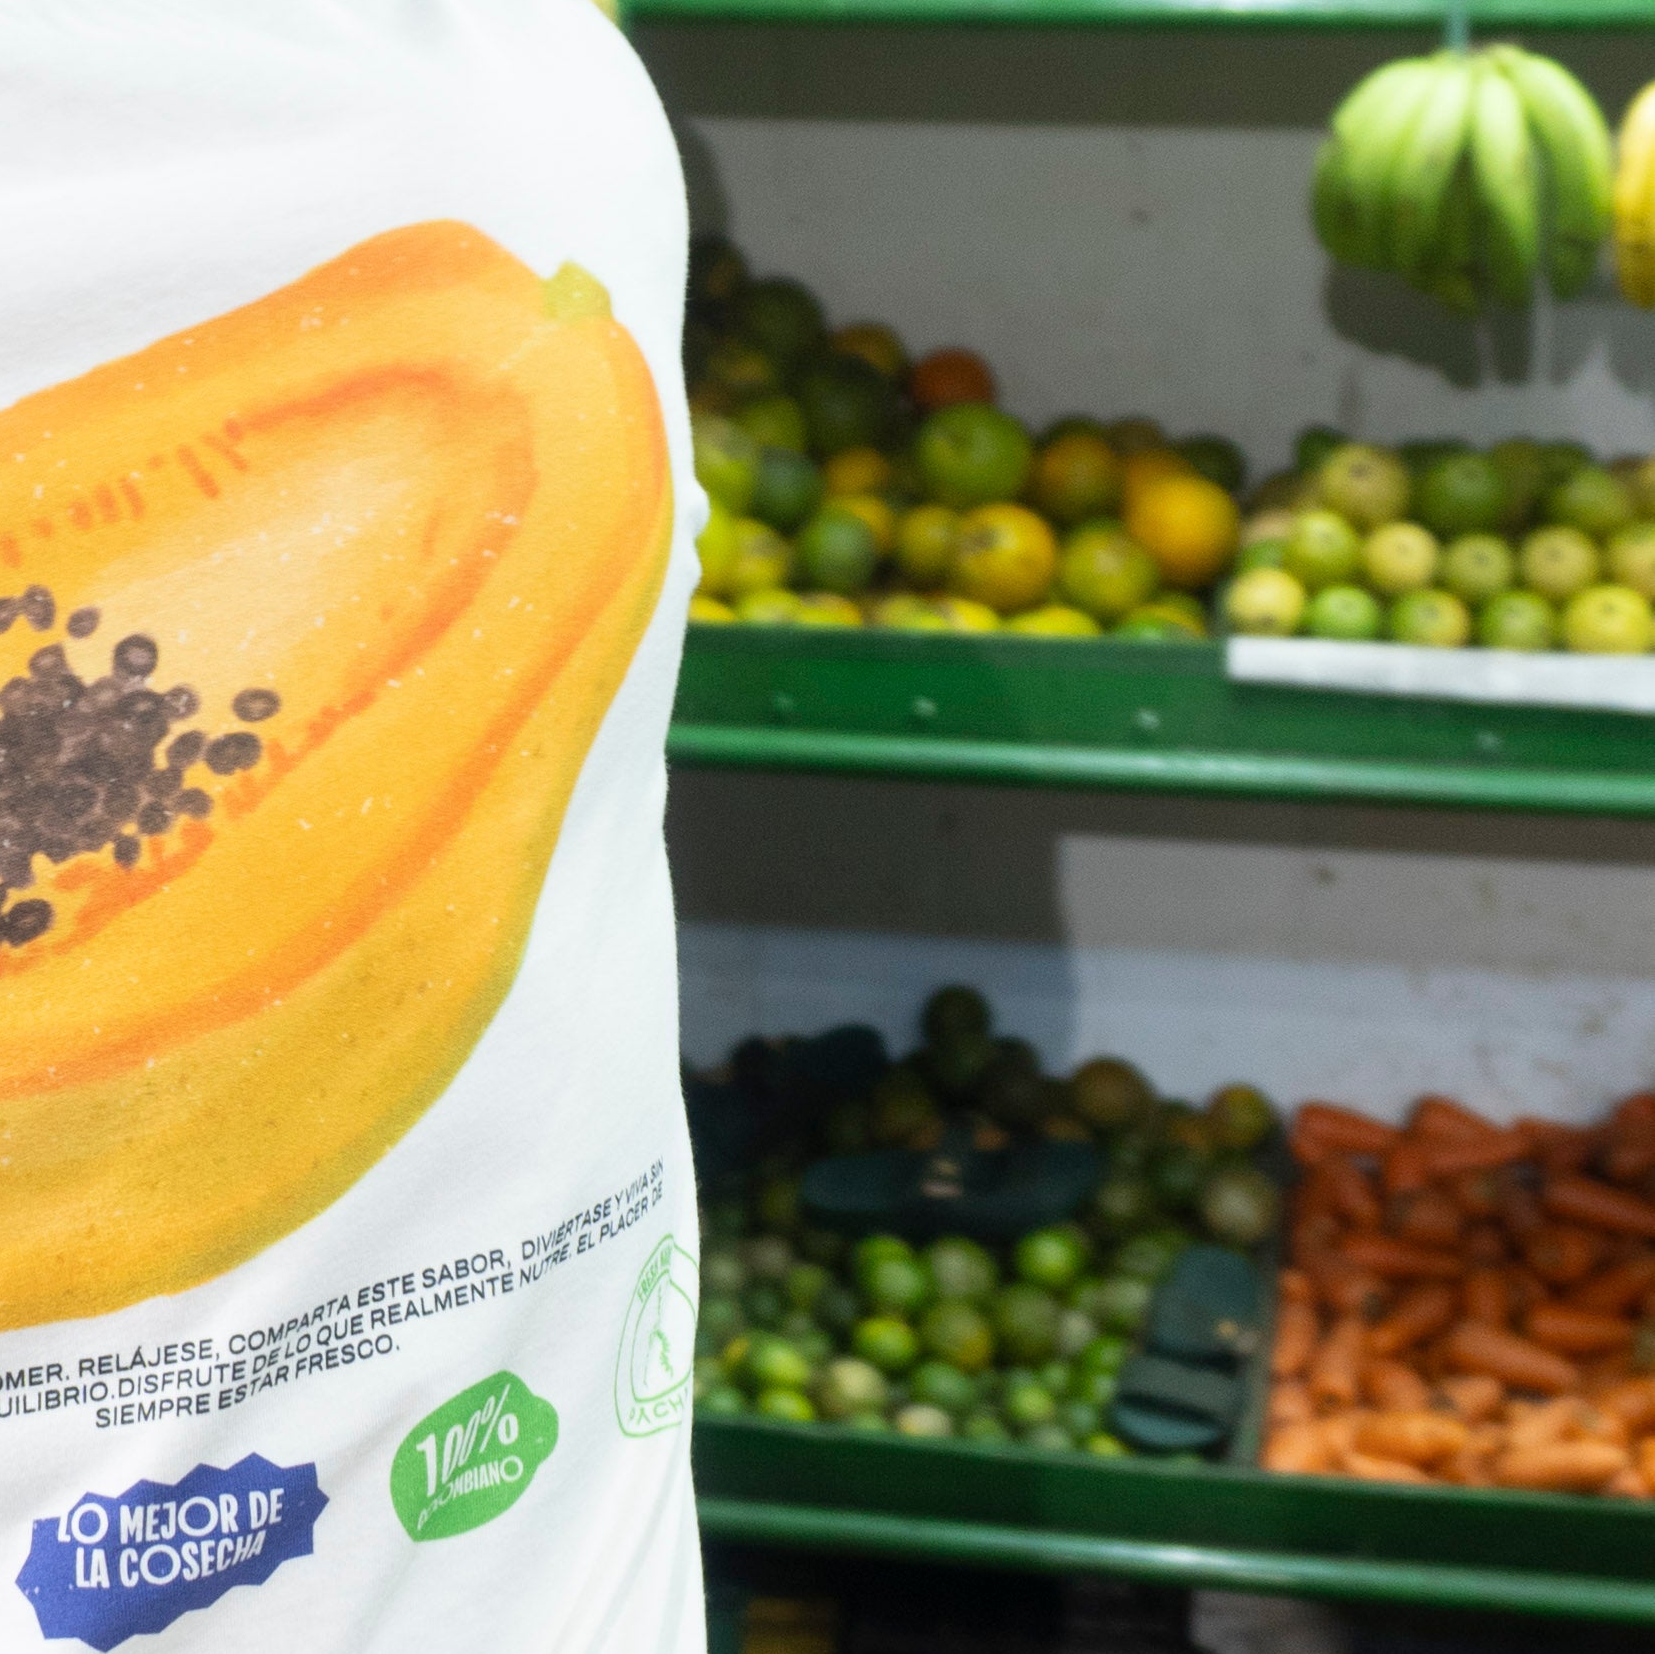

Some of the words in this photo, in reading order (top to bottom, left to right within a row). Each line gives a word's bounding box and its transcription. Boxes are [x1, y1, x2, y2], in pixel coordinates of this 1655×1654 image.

[79, 1339, 221, 1378] RELÁJESE,
[228, 1294, 351, 1355] COMPARTA
[357, 1273, 416, 1308] ESTE
[422, 1249, 512, 1289] SABOR,
[521, 1197, 612, 1261] DIVIÉRTASE
[614, 1189, 625, 1211] Y
[626, 1172, 649, 1205] VIVA
[252, 1347, 280, 1375] DE
[284, 1333, 312, 1360] LO
[317, 1314, 364, 1347] QUE
[371, 1272, 515, 1330] REALMENTE
[520, 1242, 572, 1288] NUTRE.
[576, 1231, 596, 1256] EL
[599, 1196, 649, 1244] PLACER
[95, 1392, 211, 1429] SIEMPRE
[218, 1364, 290, 1411] ESTAR
[295, 1333, 400, 1379] FRESCO.
[415, 1382, 520, 1498] 100%
[58, 1501, 110, 1545] LO
[119, 1493, 239, 1545] MEJOR
[248, 1487, 286, 1531] DE
[75, 1546, 111, 1589] LA
[119, 1529, 267, 1587] COSECHA
